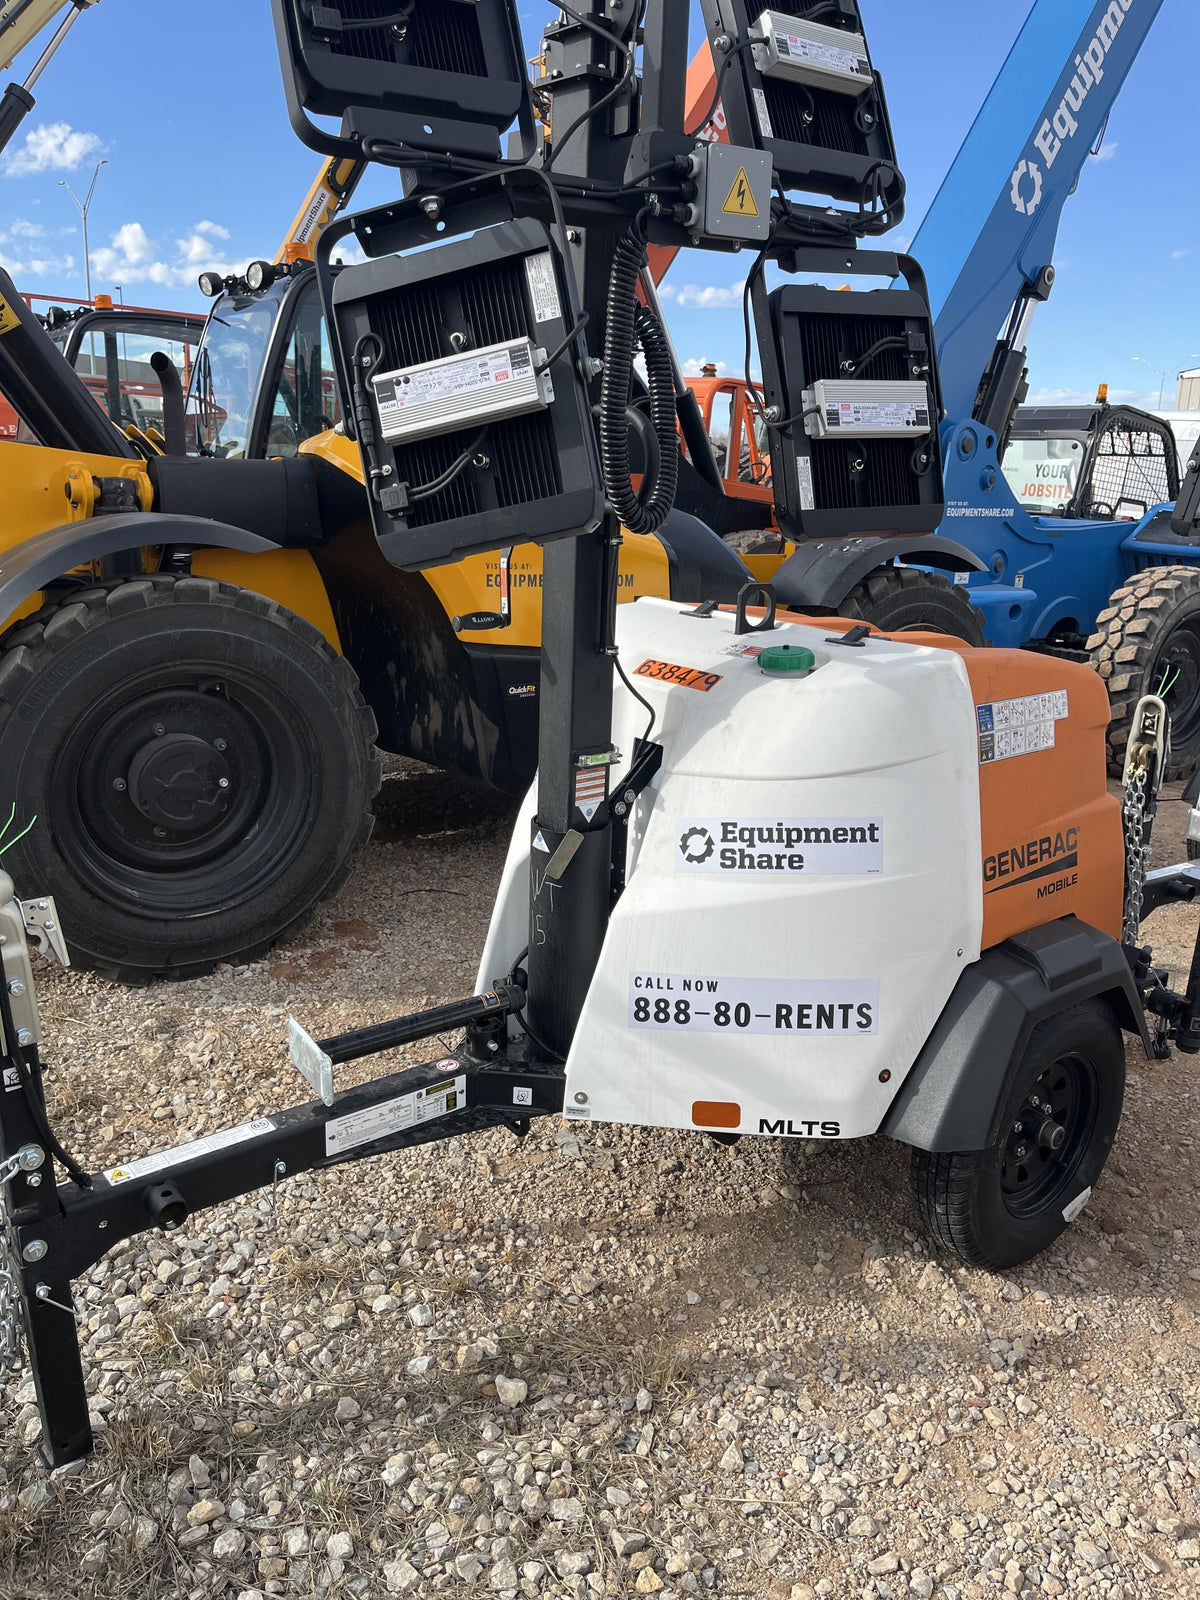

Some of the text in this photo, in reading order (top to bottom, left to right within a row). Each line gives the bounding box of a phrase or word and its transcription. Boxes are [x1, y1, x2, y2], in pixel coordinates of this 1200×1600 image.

[1035, 463, 1068, 479] YOUR
[1021, 483, 1071, 499] JOBSITE
[946, 508, 1014, 517] EQUIPMENTSHARE.COM
[636, 659, 721, 691] 638479
[508, 685, 535, 694] QuickFit
[720, 822, 880, 848] Equipment
[719, 848, 804, 870] Share
[983, 827, 1078, 882] GENERAC
[1036, 873, 1079, 900] MOBILE
[634, 976, 719, 993] CALL NOW
[633, 996, 873, 1030] 888-80-RENTS
[759, 1118, 841, 1137] MLTS
